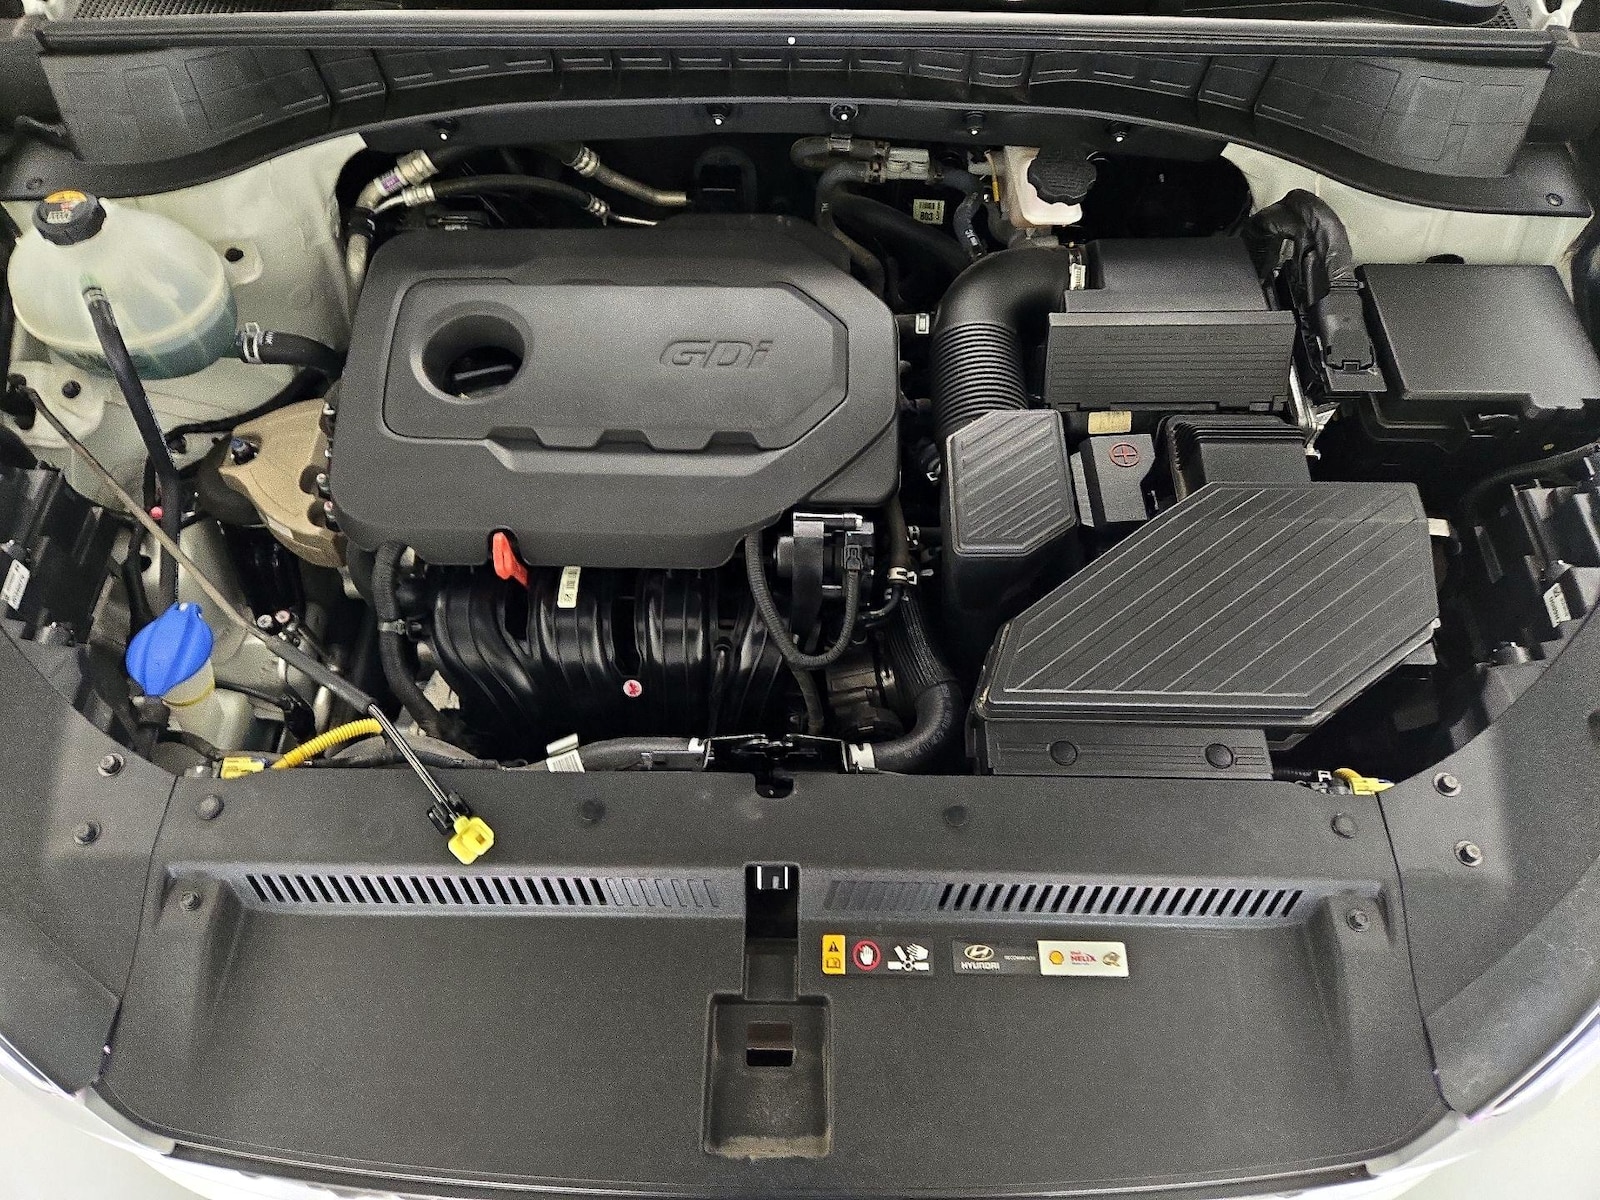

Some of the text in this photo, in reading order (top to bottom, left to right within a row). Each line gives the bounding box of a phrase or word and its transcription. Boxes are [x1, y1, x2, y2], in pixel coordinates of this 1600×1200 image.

[659, 340, 774, 368] GDi
[1070, 954, 1097, 962] HELIX
[960, 961, 1000, 970] HYUNDAI
